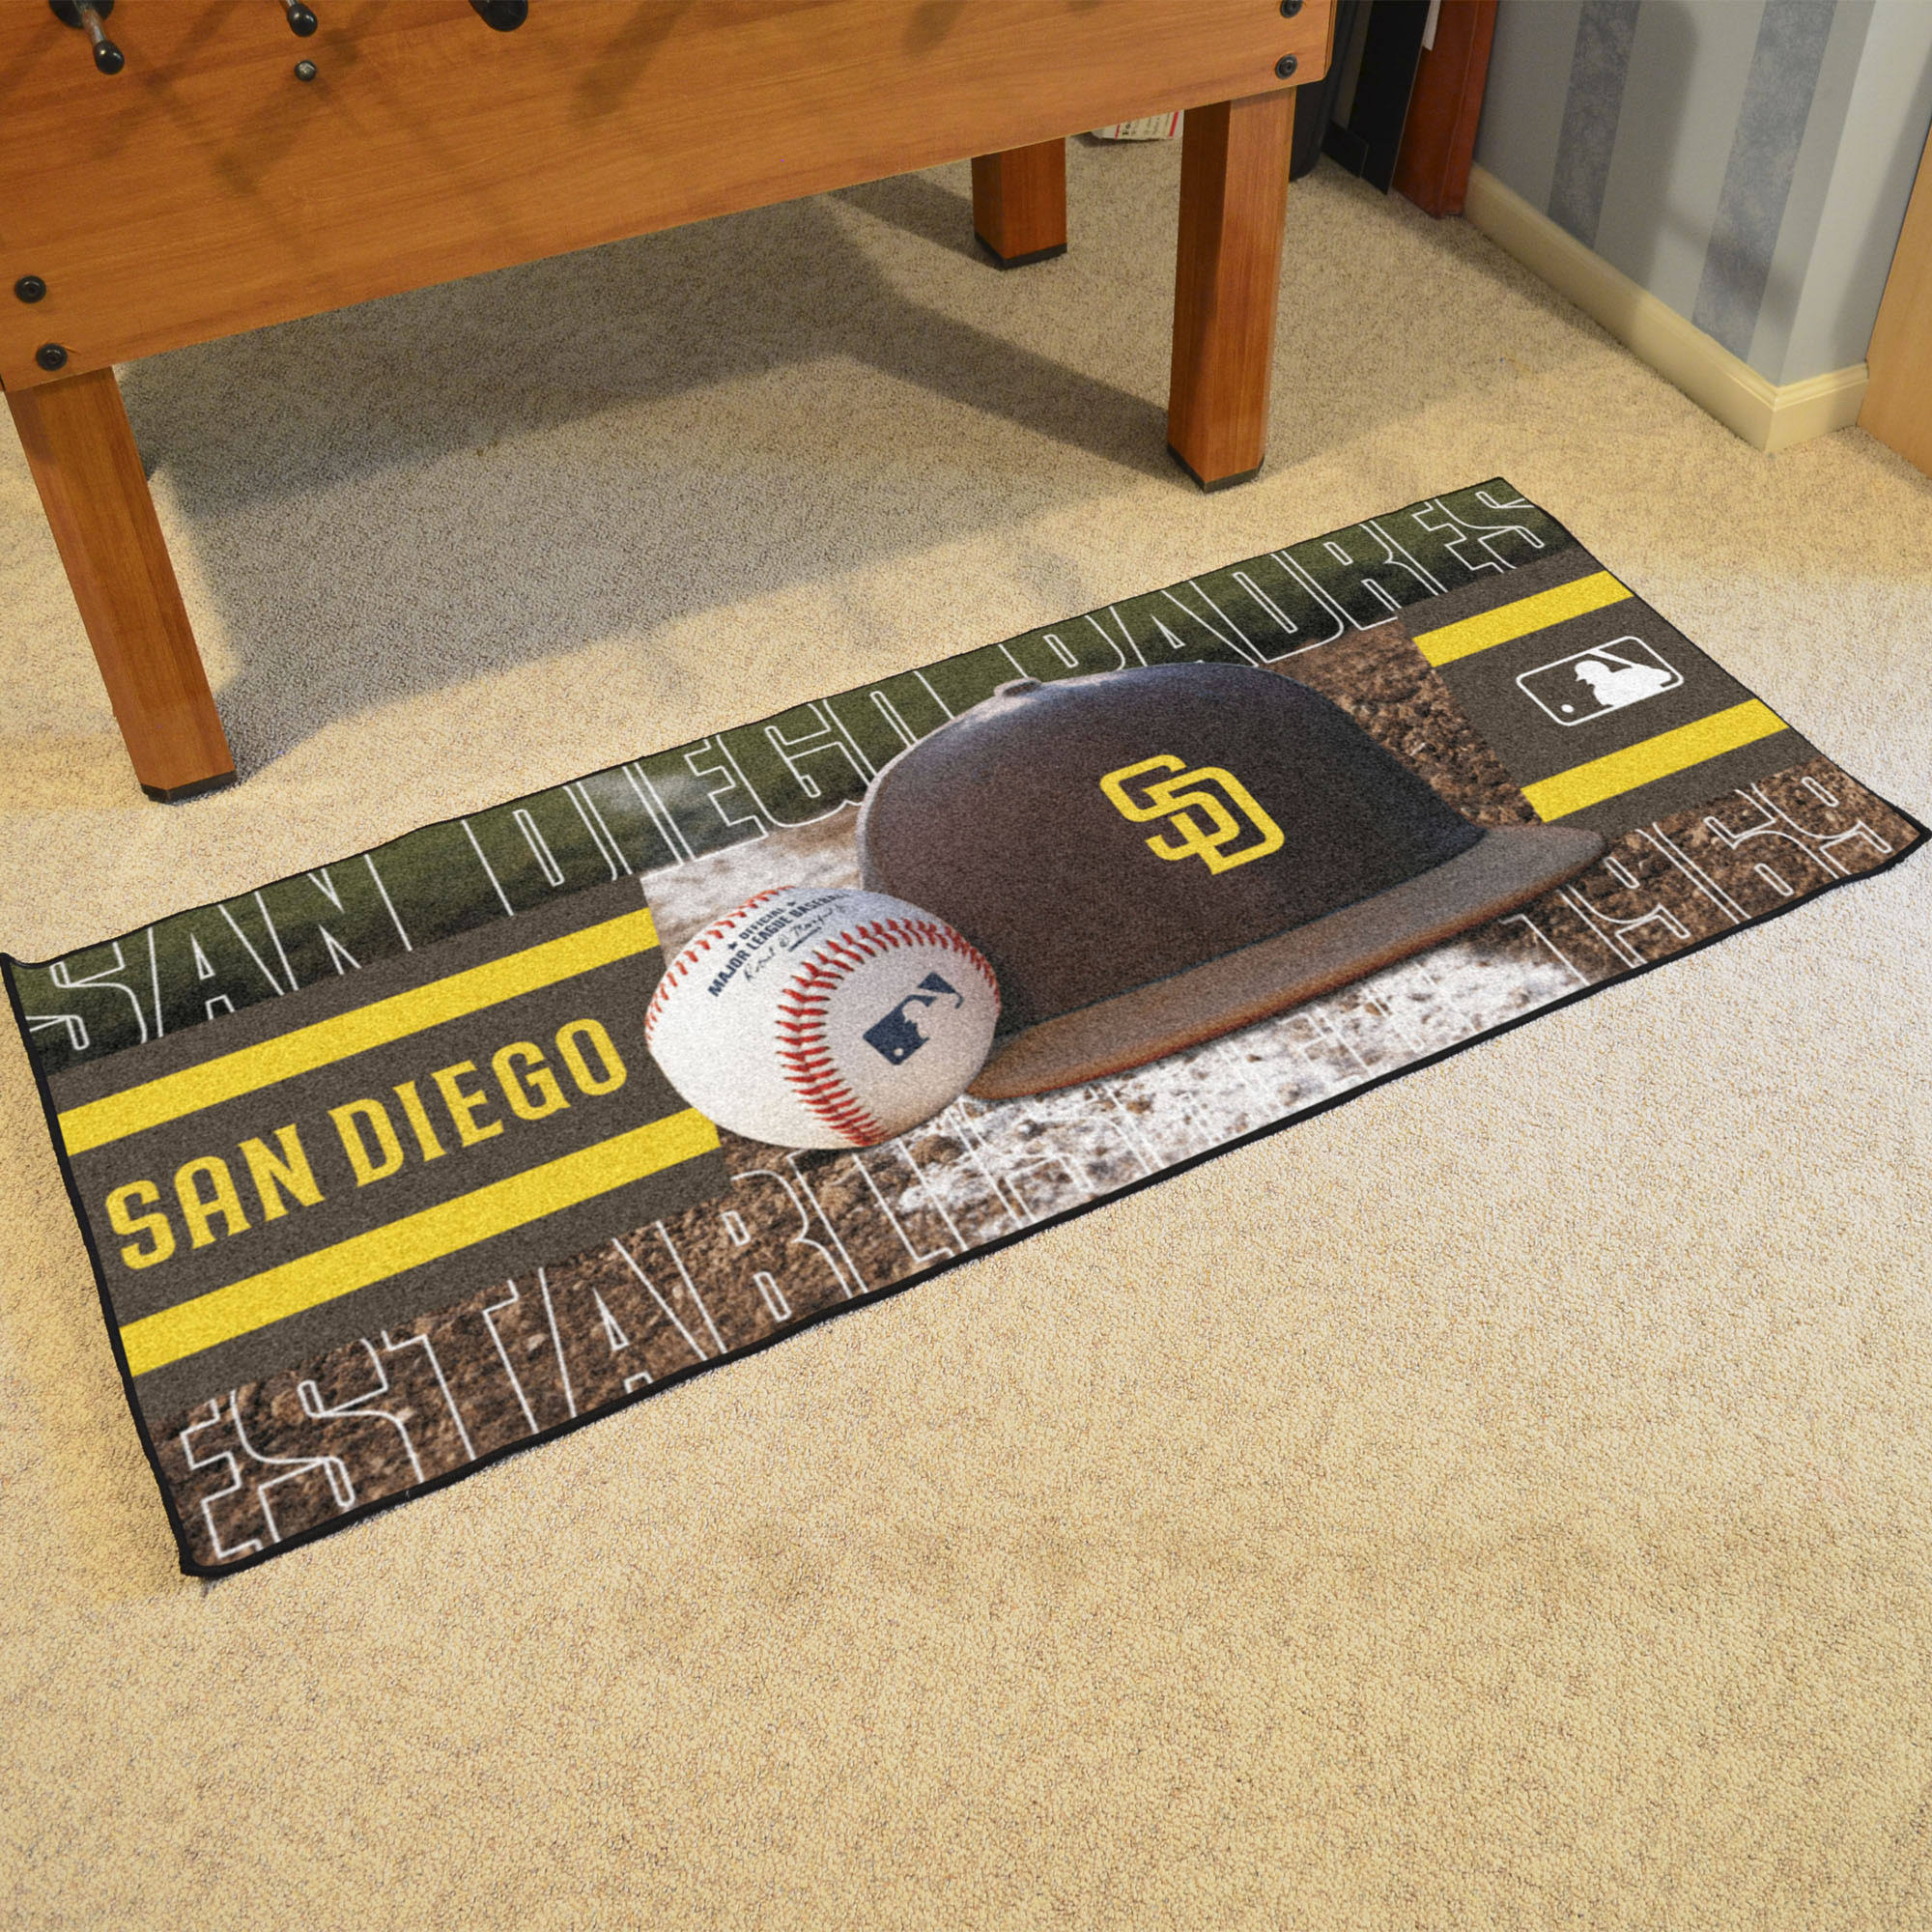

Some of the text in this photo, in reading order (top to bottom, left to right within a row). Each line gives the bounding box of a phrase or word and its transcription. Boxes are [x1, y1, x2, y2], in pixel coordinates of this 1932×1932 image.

[26, 853, 413, 1051] SAN
[461, 670, 956, 917] DIEGO
[707, 950, 751, 997] MAJOR
[746, 913, 793, 950] LEAGUE
[789, 893, 850, 918] BASEBALL
[739, 907, 786, 940] OFFICIAL
[104, 1018, 628, 1270] SAN DIEGO
